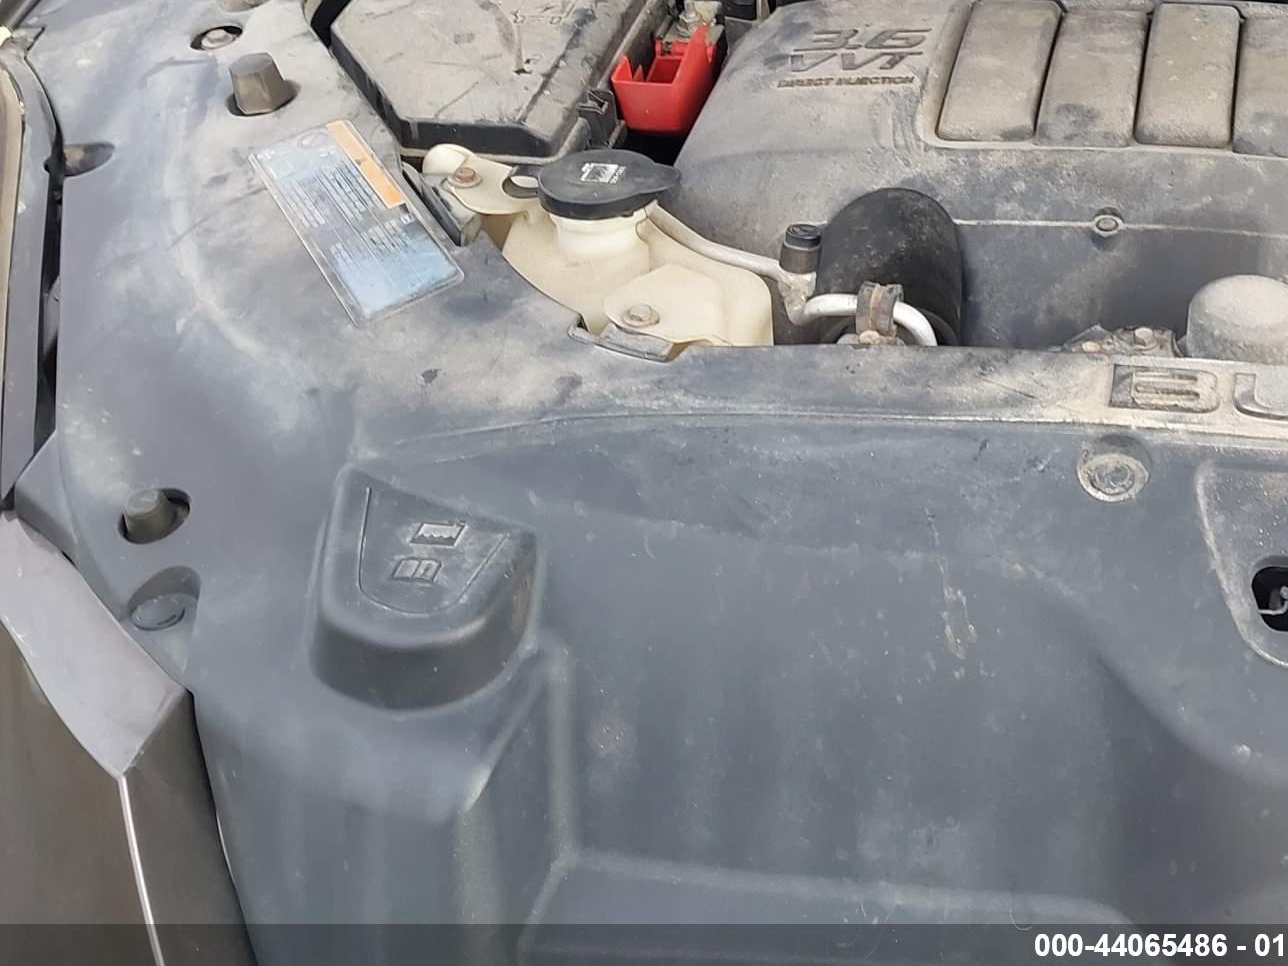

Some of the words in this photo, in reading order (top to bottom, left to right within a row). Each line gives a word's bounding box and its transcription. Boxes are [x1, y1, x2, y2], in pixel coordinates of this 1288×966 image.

[793, 29, 932, 50] 3.6
[790, 51, 923, 72] VVT
[777, 77, 834, 88] DIRECT
[836, 76, 915, 86] INJECTION
